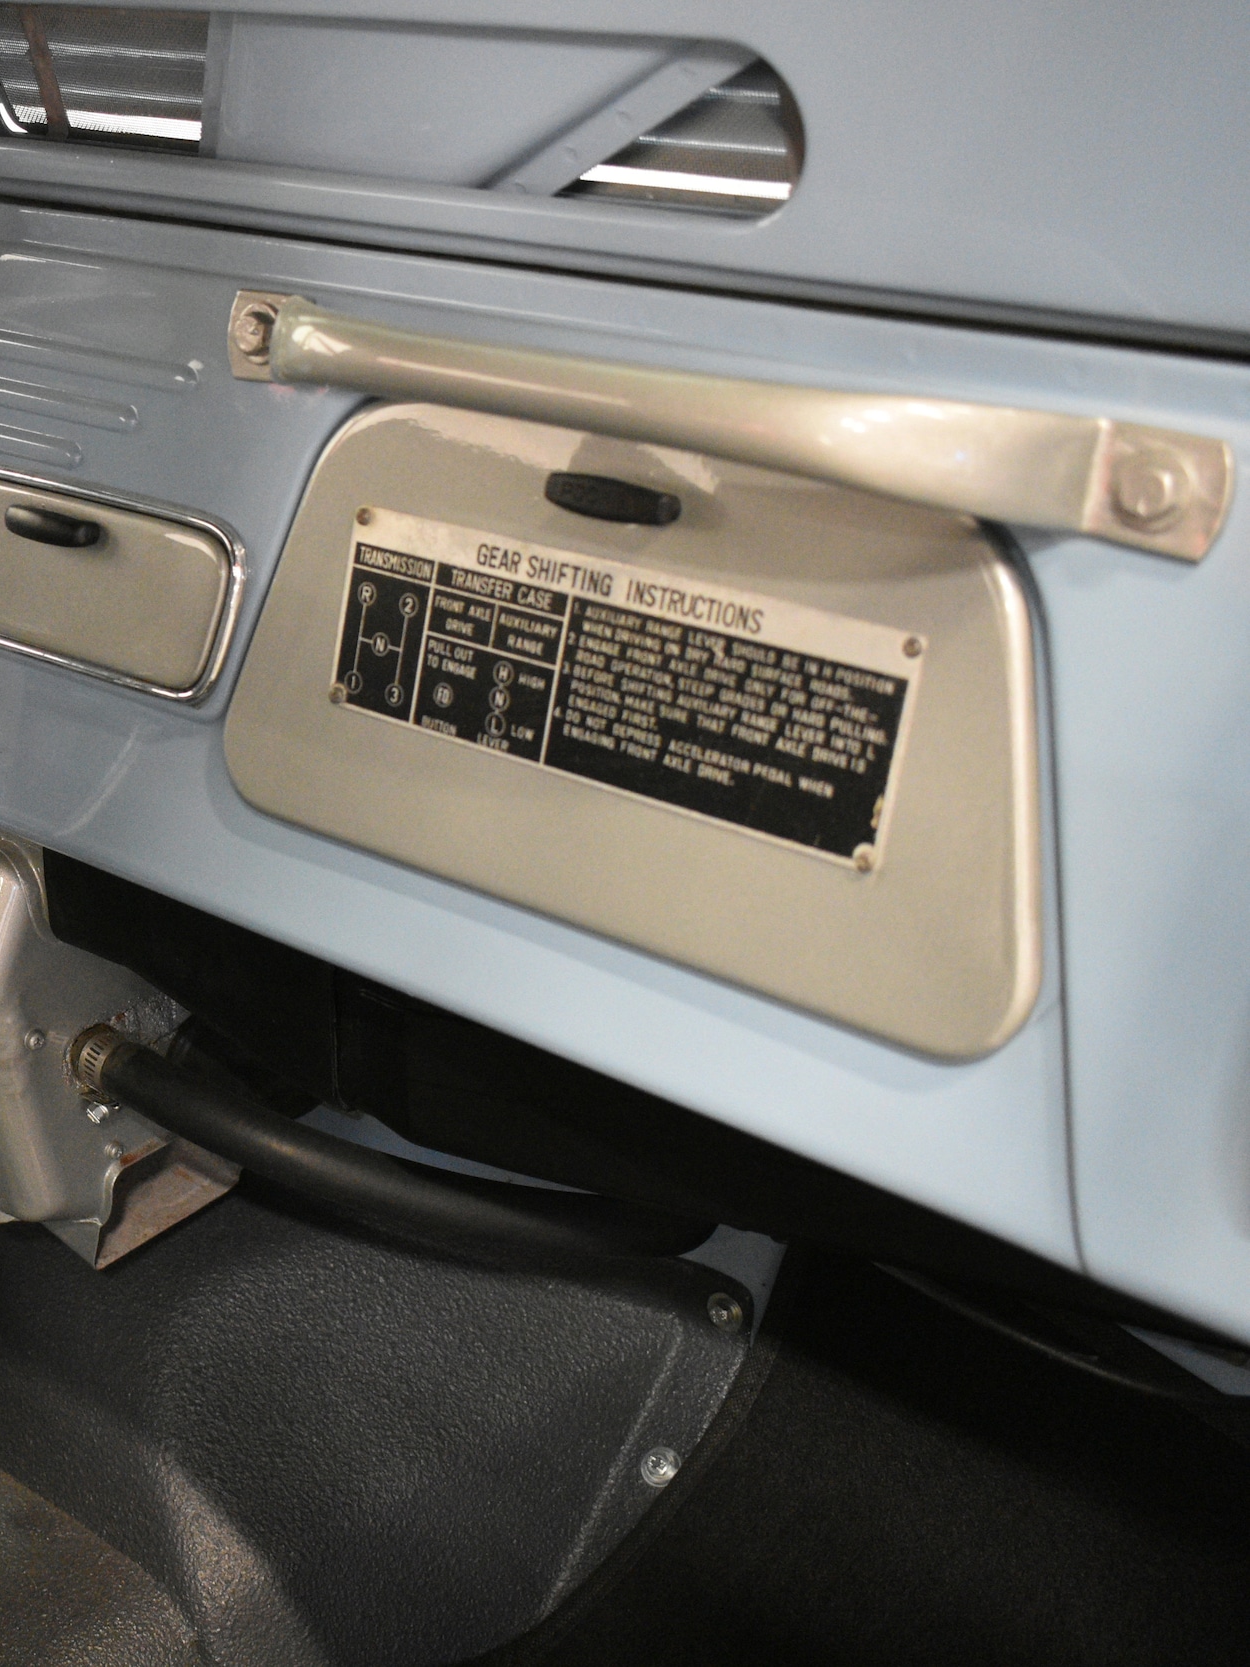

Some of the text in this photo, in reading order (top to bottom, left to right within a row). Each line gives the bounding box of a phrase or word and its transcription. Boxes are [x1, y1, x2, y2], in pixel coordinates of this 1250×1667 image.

[359, 546, 431, 579] TRANSMISSION
[361, 585, 371, 602] R
[451, 569, 552, 610] TRANSFER CASE
[476, 543, 763, 633] GEAR SHIFTING INSTRUCTIONS
[404, 597, 412, 613] 2
[434, 595, 491, 621] FRONT AXLE
[445, 617, 473, 636] DRIVE
[499, 612, 557, 639] AUXILIARY
[376, 637, 385, 651] N
[428, 639, 473, 663] PULL OUT
[507, 634, 543, 655] RANGE
[582, 619, 612, 639] WHEN
[614, 628, 662, 652] DRIVING
[664, 640, 681, 657] ON
[685, 646, 709, 664] DRY
[750, 663, 802, 688] SURFACE
[585, 604, 641, 630] AUXILIARY
[645, 619, 682, 640] RANGE
[731, 641, 776, 665] SHOULD
[781, 654, 799, 670] BE
[804, 659, 820, 676] IN
[834, 667, 895, 695] POSITION
[426, 654, 476, 679] TO ENGAGE
[499, 667, 507, 679] H
[578, 634, 619, 656] ENGAGE
[626, 646, 663, 668] FRONT
[669, 658, 697, 677] AXLE
[703, 666, 737, 688] DRIVE
[744, 677, 776, 698] ONLY
[780, 687, 807, 707] FOR
[390, 687, 398, 702] 3
[519, 673, 545, 690] HIGH
[575, 648, 605, 669] ROAD
[677, 676, 715, 699] STEEP
[719, 687, 766, 713] GRADES
[770, 701, 789, 719] OR
[791, 707, 826, 729] HARD
[568, 693, 617, 719] ENGAGED
[573, 664, 615, 687] BEFORE
[620, 677, 673, 704] SHIFTING
[677, 692, 737, 722] AUXILIARY
[740, 710, 779, 733] RANGE
[784, 722, 826, 746] LEVER
[829, 735, 862, 757] INTO
[490, 718, 499, 732] L
[511, 724, 534, 742] LOW
[624, 694, 655, 714] MAKE
[659, 703, 689, 724] SURE
[696, 714, 726, 734] THAT
[730, 724, 770, 747] FRONT
[775, 736, 807, 757] AXLE
[811, 747, 848, 769] DRIVE
[849, 757, 866, 774] IS
[563, 722, 615, 750] ENGAGING
[620, 740, 656, 762] FRONT
[663, 753, 690, 773] AXLE
[565, 708, 581, 724] DO
[586, 714, 607, 732] NOT
[612, 722, 663, 749] DEPRESS
[668, 738, 751, 775] ACCELERATOR
[752, 763, 793, 787] PEDAL
[797, 776, 834, 800] WHEN
